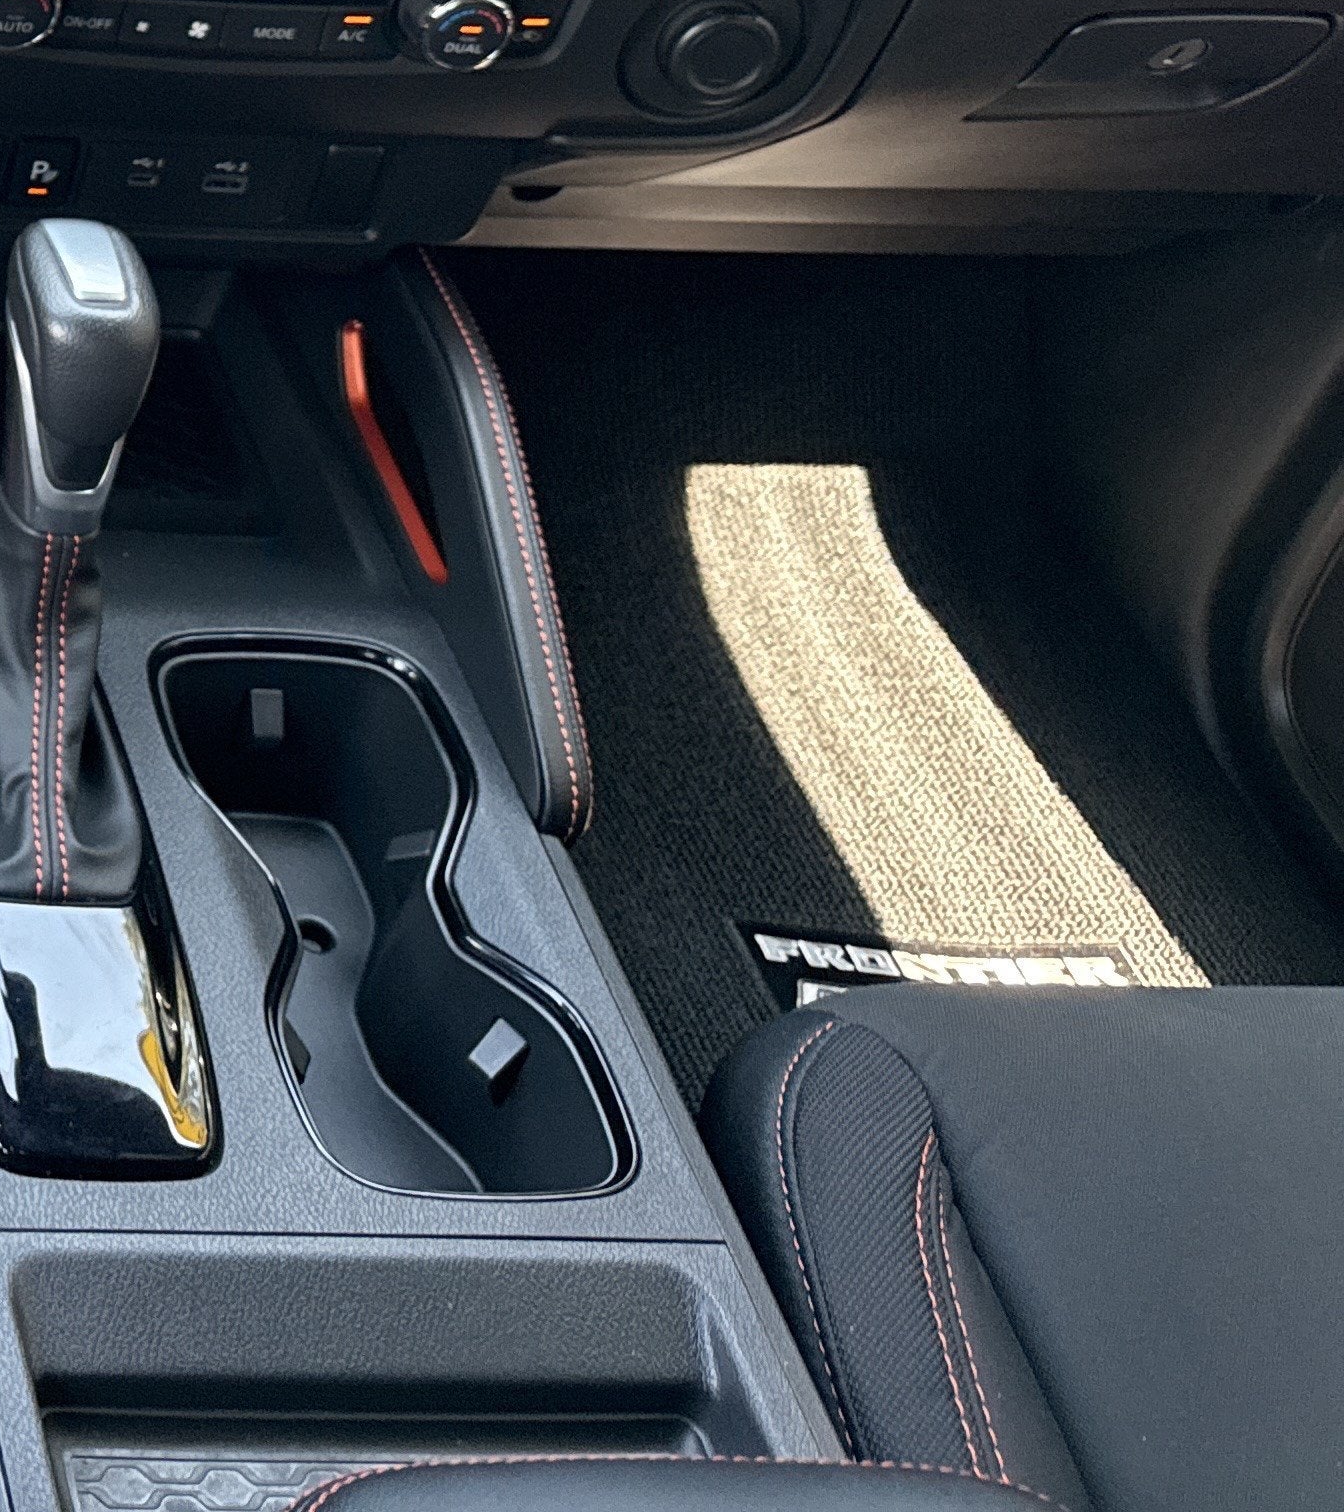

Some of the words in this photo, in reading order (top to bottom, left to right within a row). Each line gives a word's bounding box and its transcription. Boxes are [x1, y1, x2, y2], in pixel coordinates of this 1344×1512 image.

[253, 27, 296, 40] MODE
[338, 30, 367, 43] A/C
[443, 42, 483, 55] DUAL
[754, 933, 1130, 987] FRONTIER
